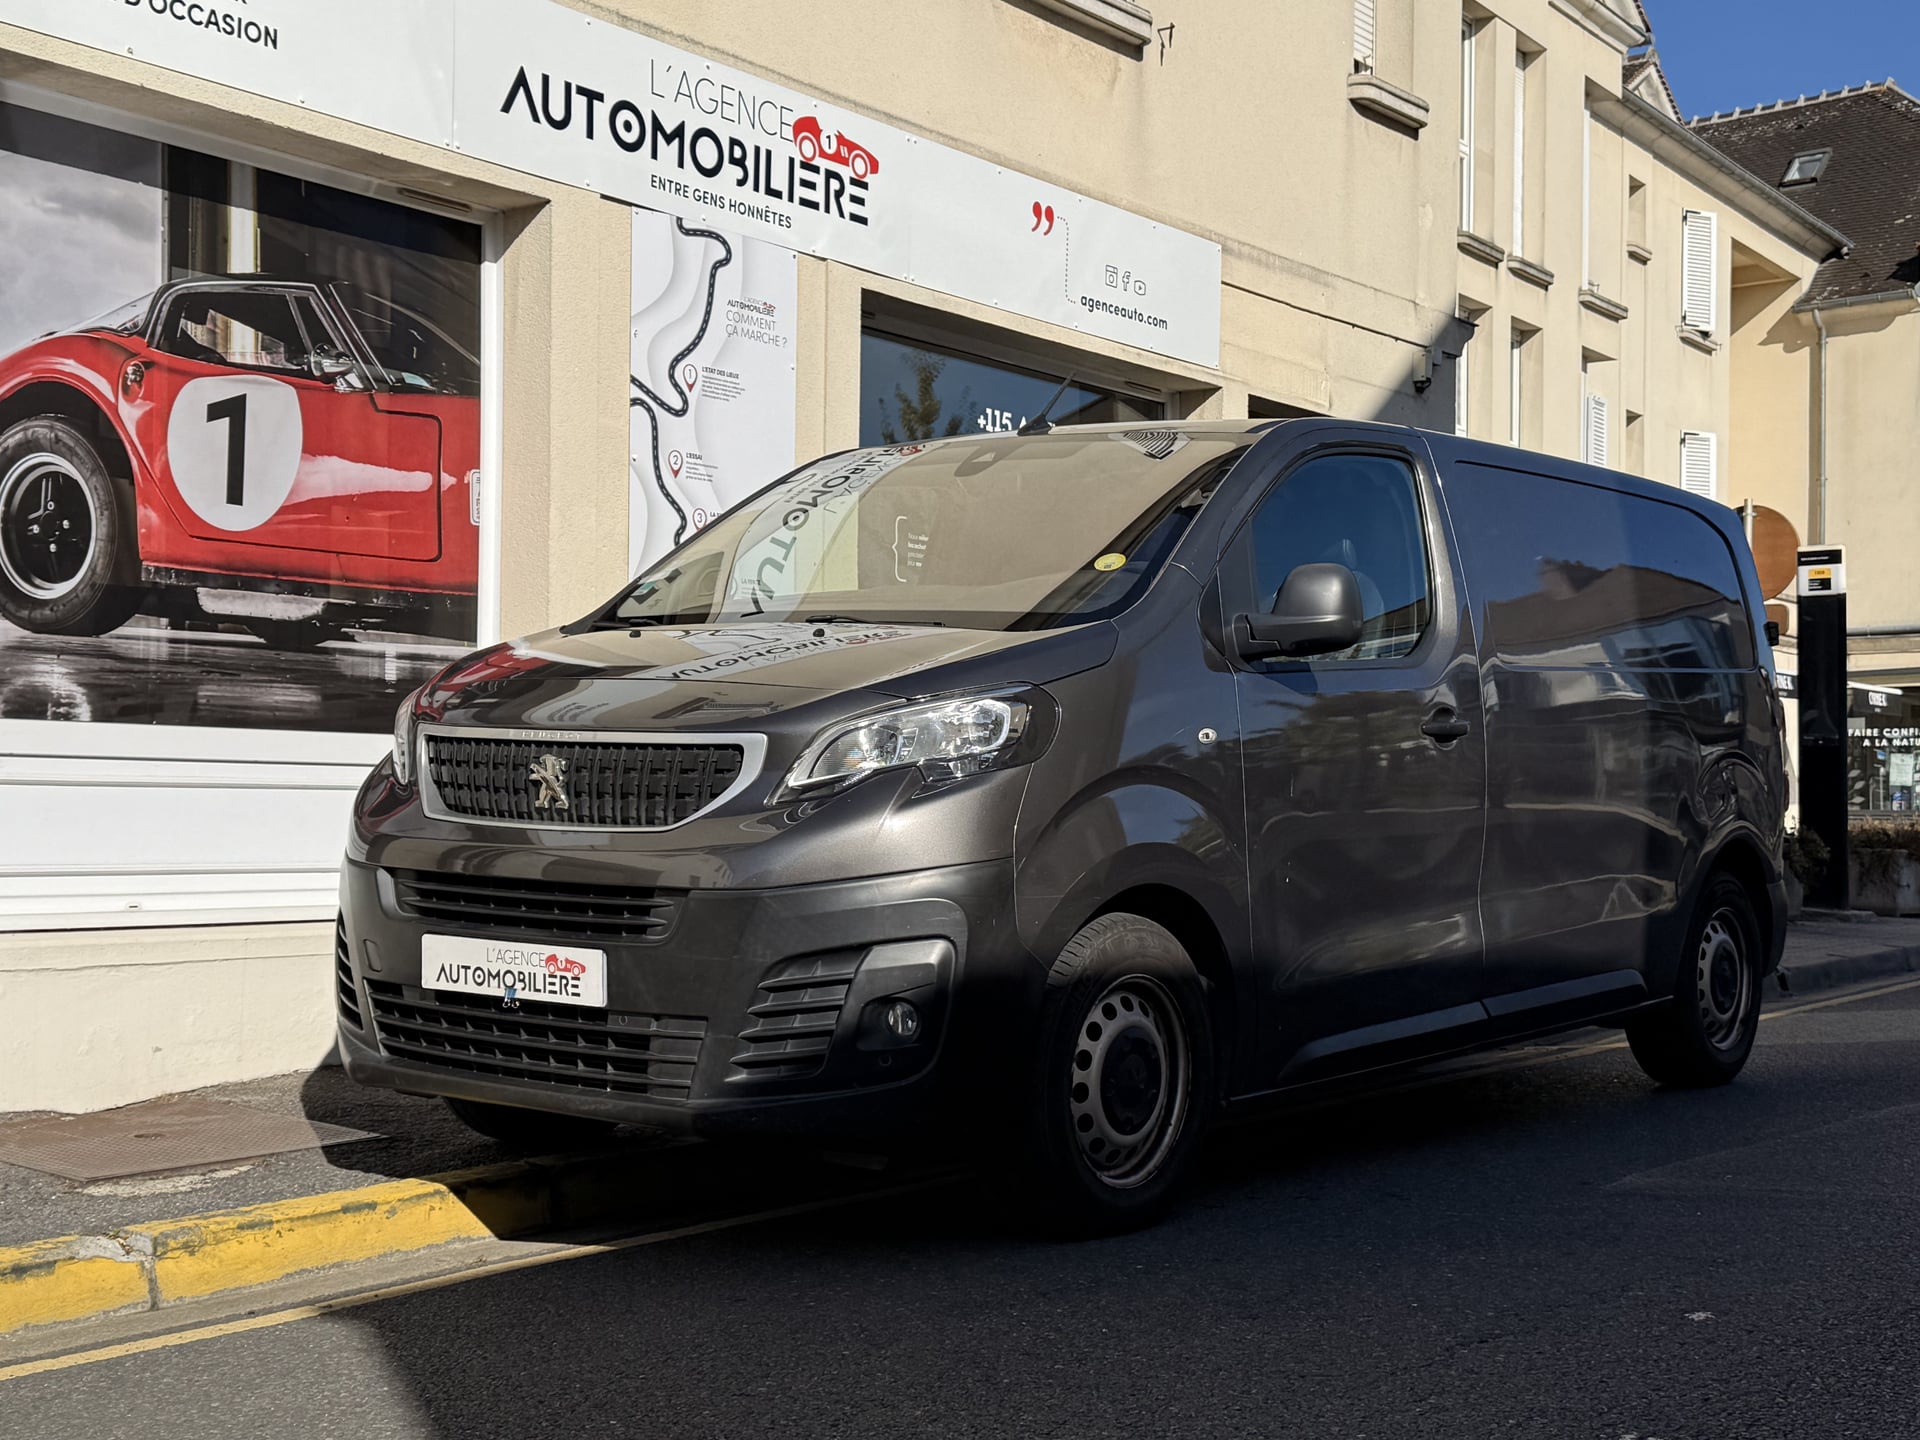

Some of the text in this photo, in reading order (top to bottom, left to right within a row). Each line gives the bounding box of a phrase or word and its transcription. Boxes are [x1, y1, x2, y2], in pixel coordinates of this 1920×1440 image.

[124, 0, 278, 50] OCCASION
[650, 58, 795, 142] L'AGENCE
[499, 65, 870, 227] AUTOMOBILIERE
[650, 173, 792, 229] ENTRE GENS HONNÊTES
[726, 309, 776, 332] COMMENT
[1080, 294, 1168, 330] agenceauto.com
[725, 323, 739, 338] ÇA
[740, 327, 781, 348] MARCHE
[688, 368, 693, 379] 1
[206, 393, 247, 507] 1
[672, 454, 679, 466] 2
[697, 512, 703, 523] 3
[1847, 728, 1920, 738] FAIRE CONFI
[1874, 738, 1889, 748] LA
[486, 947, 546, 968] L'AGENCE
[436, 962, 581, 998] AUTOMOBILIERE
